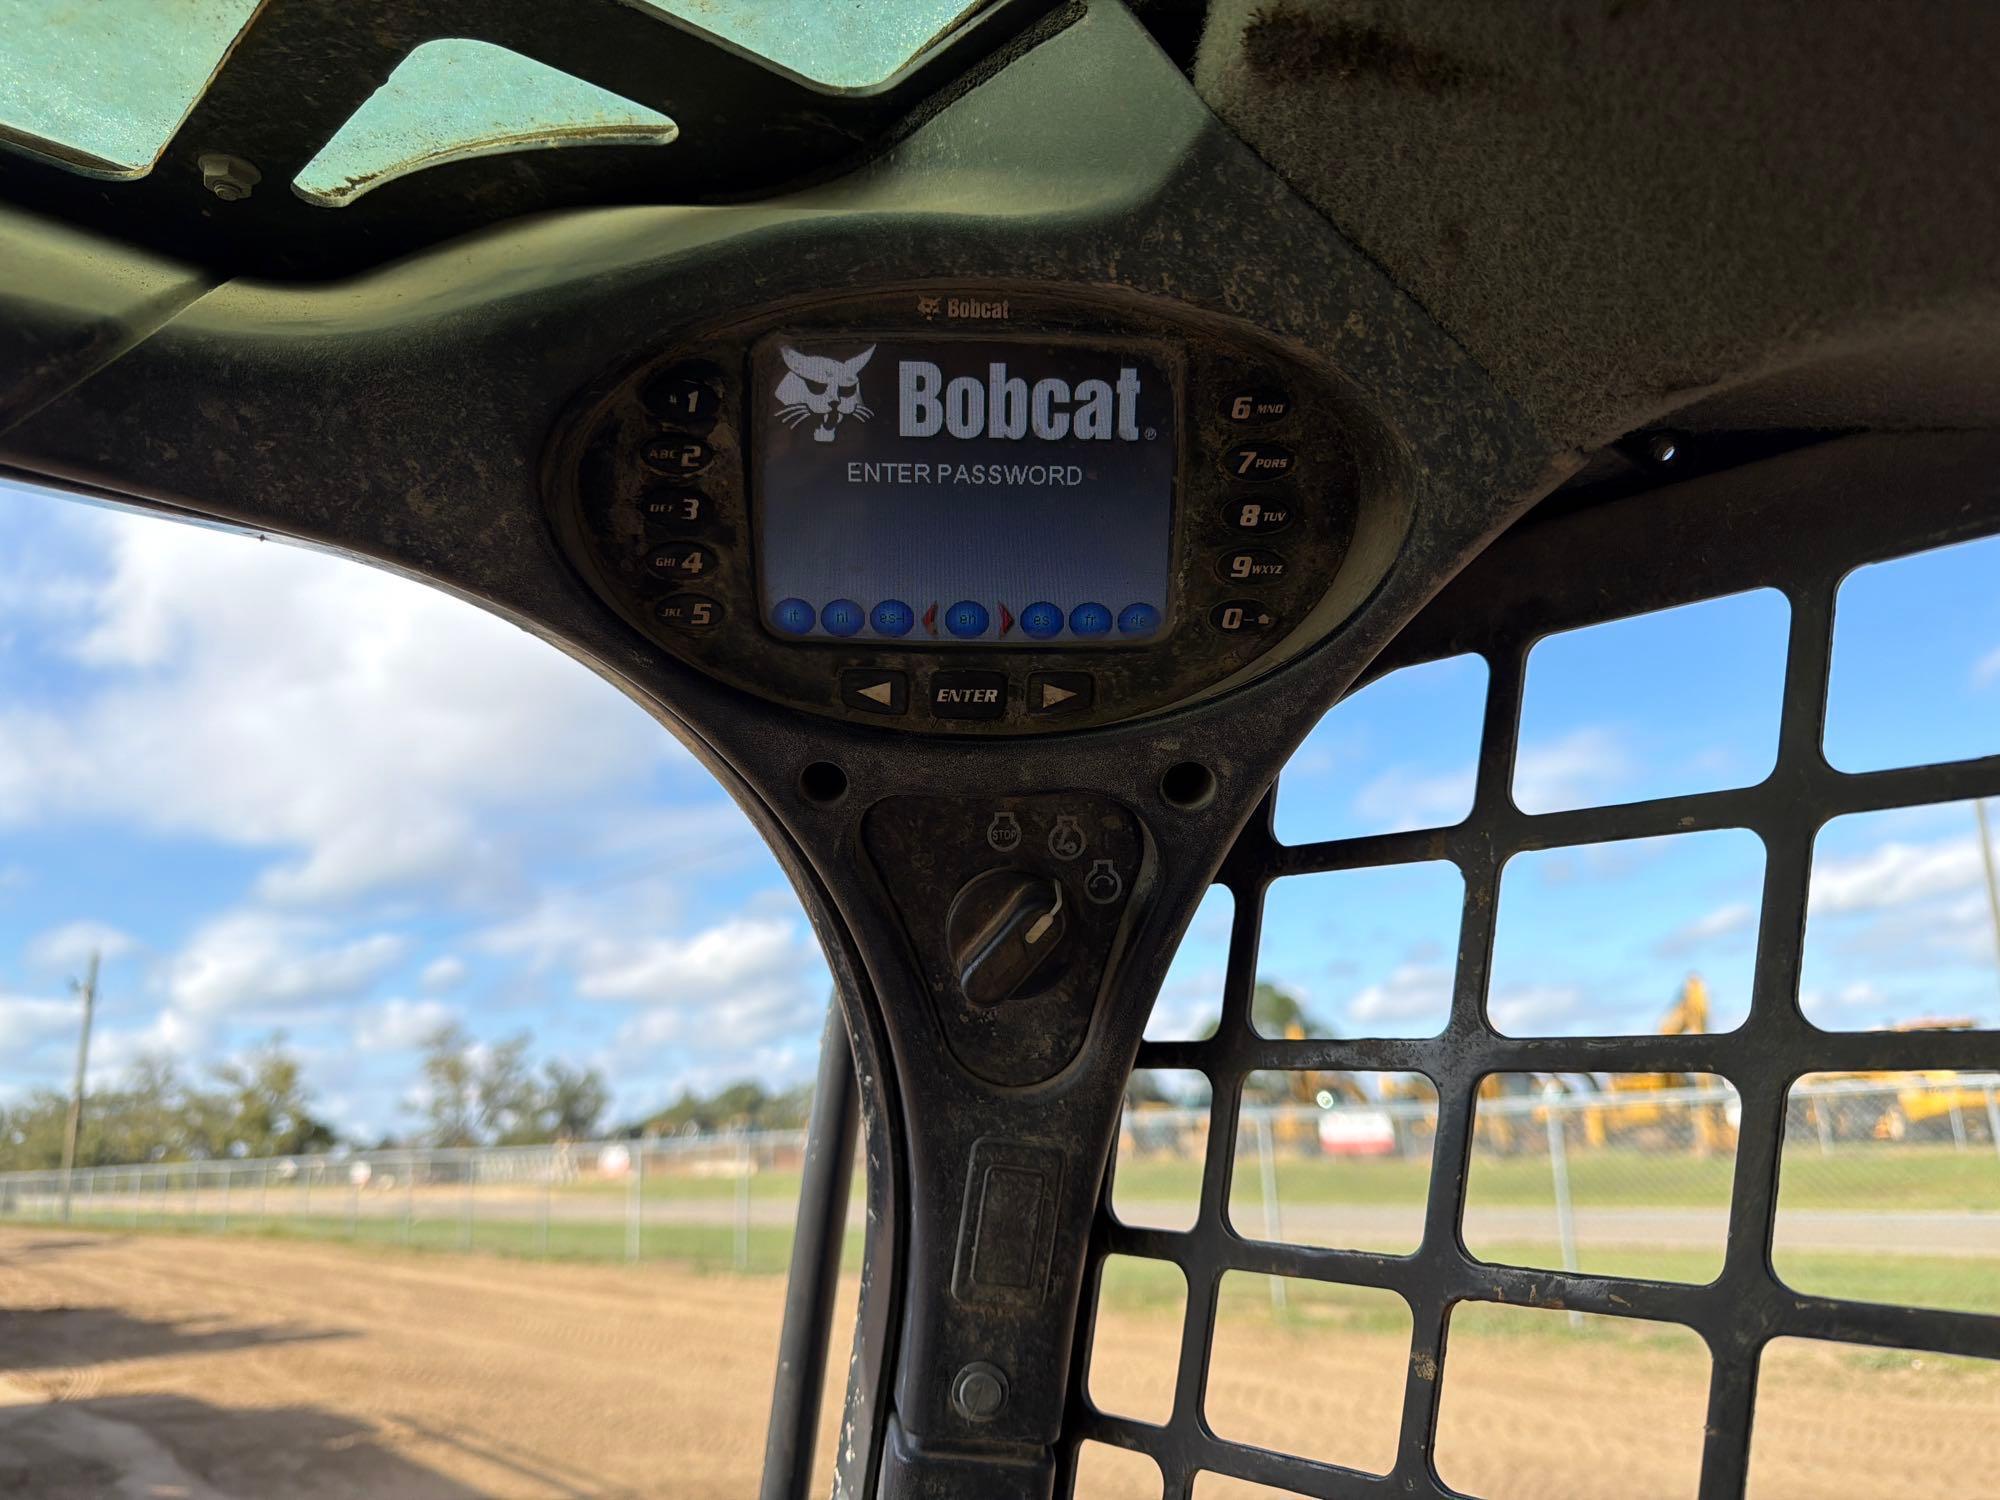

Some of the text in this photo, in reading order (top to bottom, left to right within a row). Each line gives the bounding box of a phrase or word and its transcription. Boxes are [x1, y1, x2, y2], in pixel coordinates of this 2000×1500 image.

[947, 298, 1009, 319] Bobcat
[687, 390, 699, 413] 1
[898, 360, 1141, 441] Bobcat
[1231, 396, 1285, 420] 6 MNO
[681, 444, 702, 468] 2
[1237, 451, 1257, 474] 7
[847, 462, 1083, 487] ENTER PASSWORD
[681, 498, 700, 521] 3
[1240, 504, 1288, 527] 8 TUV
[655, 551, 704, 574] GHI 4
[1230, 556, 1286, 578] 9 WXYZ
[691, 603, 712, 625] 5
[959, 613, 978, 625] en
[1033, 615, 1050, 626] es
[1221, 607, 1243, 629] 0
[936, 688, 998, 703] ENTER
[992, 829, 1020, 841] STOP
